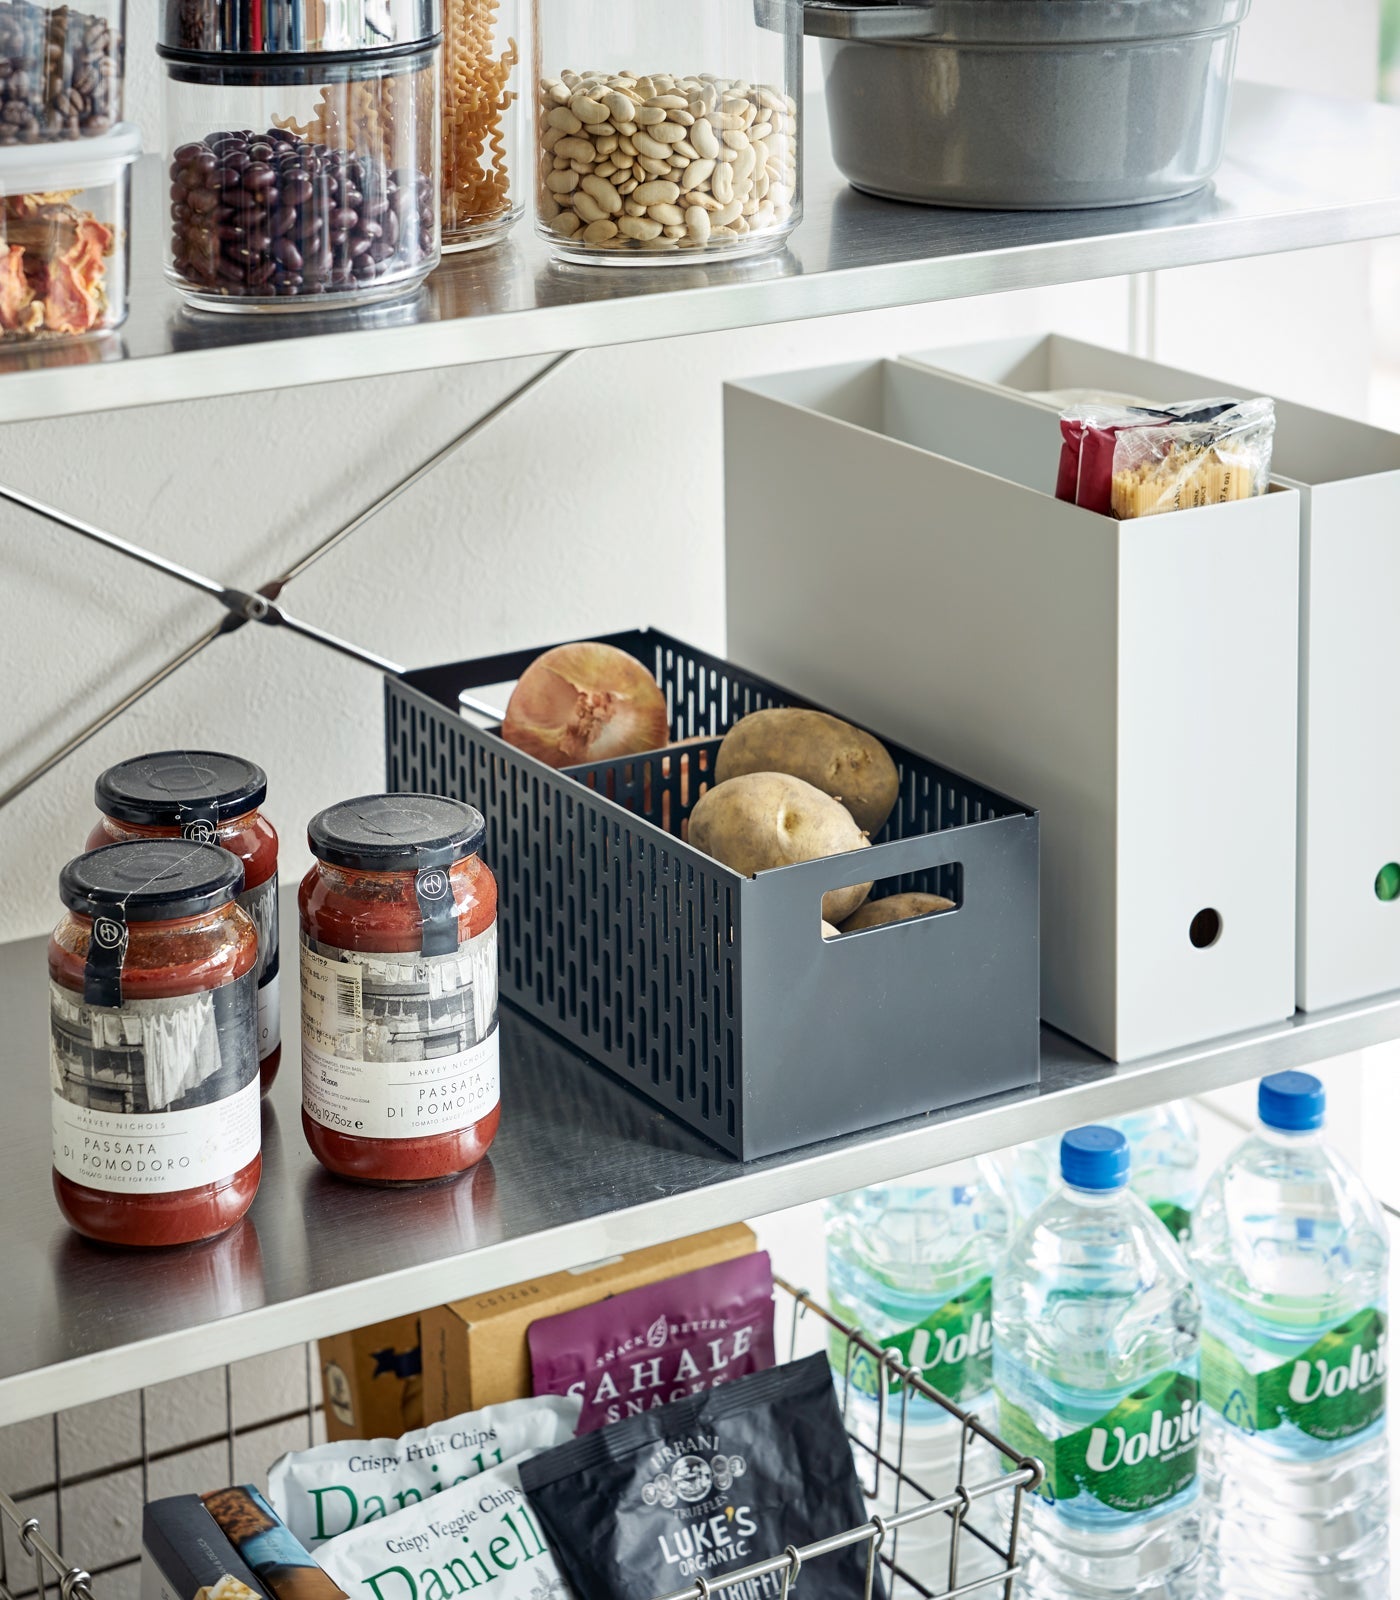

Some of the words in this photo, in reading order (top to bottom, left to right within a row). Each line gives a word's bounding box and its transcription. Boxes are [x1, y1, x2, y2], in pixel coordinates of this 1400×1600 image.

[409, 1065, 447, 1077] HARVEY
[419, 1074, 481, 1099] PASSATA
[387, 1107, 404, 1118] DI
[417, 1076, 495, 1116] POMODORO
[77, 1116, 110, 1129] HARVEY
[116, 1121, 166, 1130] NICHOLS
[411, 1119, 439, 1127] TOMATO
[64, 1145, 75, 1160] DI
[82, 1153, 190, 1172] POMODORO
[84, 1137, 157, 1155] PASSATA
[104, 1174, 126, 1182] SAUCE
[595, 1335, 645, 1368] SNACK
[669, 1318, 728, 1334] BETTER
[567, 1326, 752, 1404] SAHALE
[348, 1456, 401, 1473] Crispy
[405, 1439, 446, 1463] Fruit
[450, 1424, 498, 1451] Chips
[650, 1435, 720, 1470] URBANI
[386, 1532, 430, 1555] Crispy
[428, 1509, 479, 1538] Veggie
[478, 1485, 522, 1514] Chips
[672, 1492, 730, 1520] TRUFFLES
[658, 1505, 758, 1564] LUKE'S
[678, 1540, 748, 1577] ORGANIC
